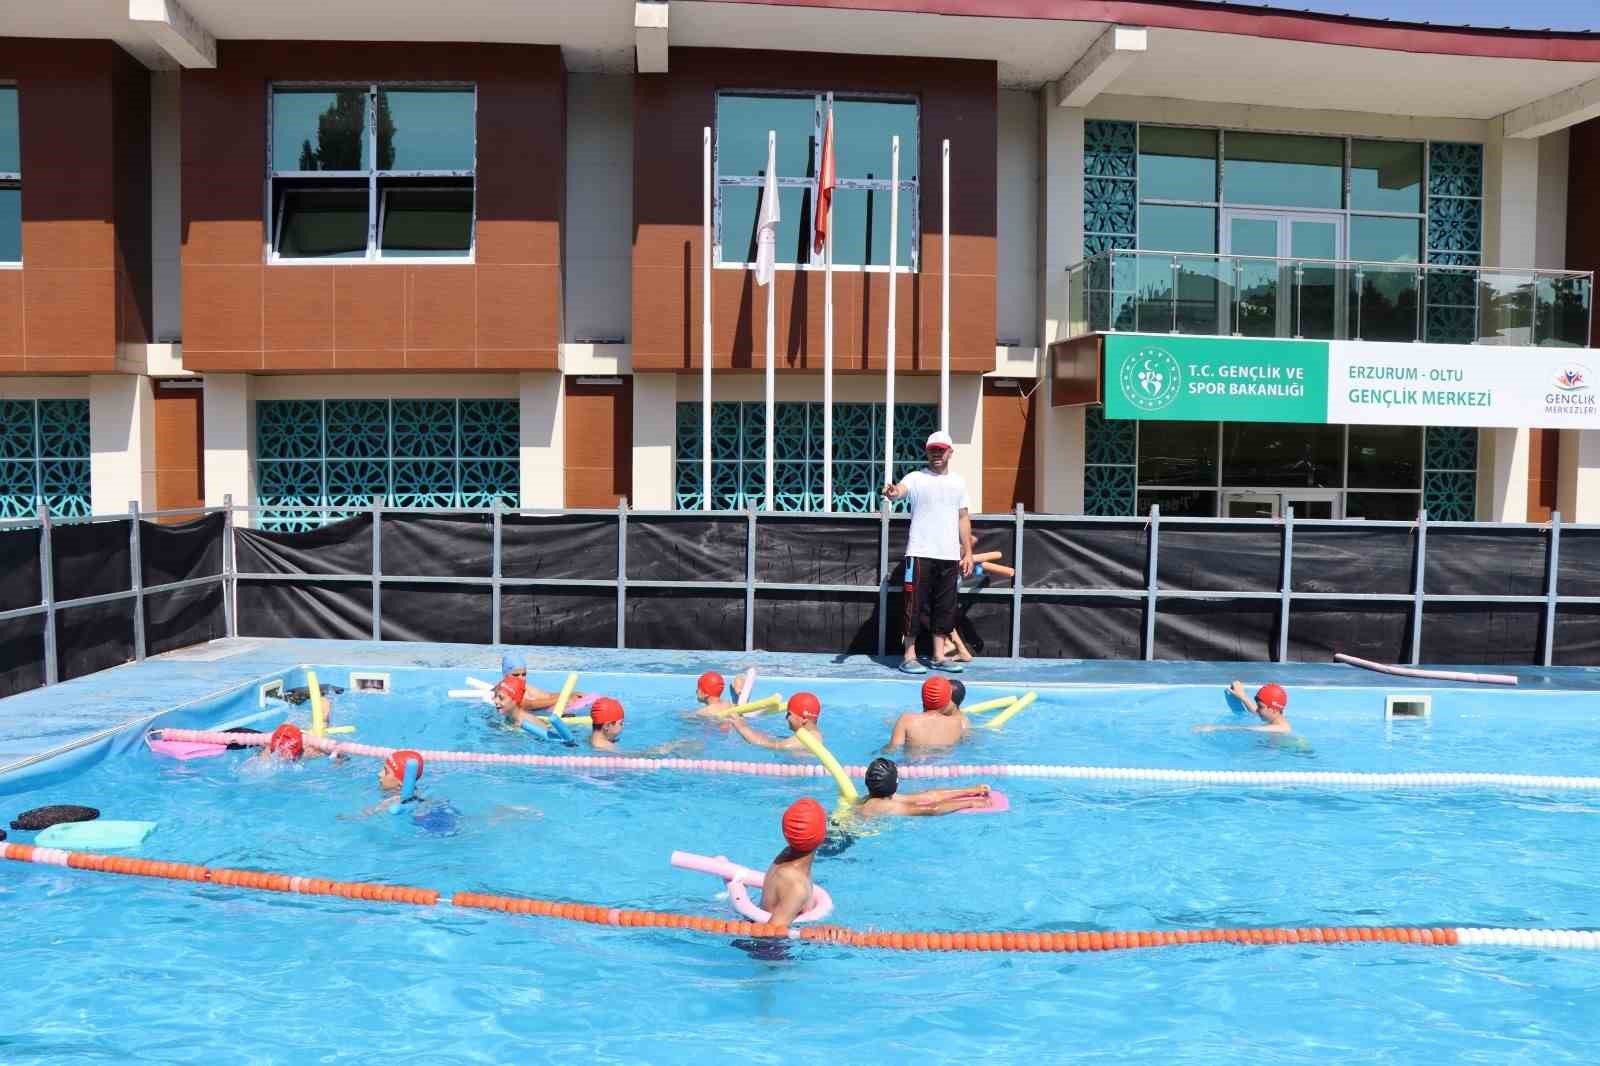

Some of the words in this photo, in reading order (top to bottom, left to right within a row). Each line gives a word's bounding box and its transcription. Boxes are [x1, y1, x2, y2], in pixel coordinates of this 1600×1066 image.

[1189, 364, 1215, 377] T.C.
[1219, 364, 1281, 382] GENÇLİK
[1286, 367, 1305, 380] VE
[1349, 365, 1418, 381] ERZURUM
[1430, 368, 1464, 382] OLTU
[1188, 381, 1225, 395] SPOR
[1229, 382, 1305, 398] BAKANLIĞI
[1349, 386, 1417, 409] GENÇLİK
[1422, 388, 1492, 408] MERKEZİ
